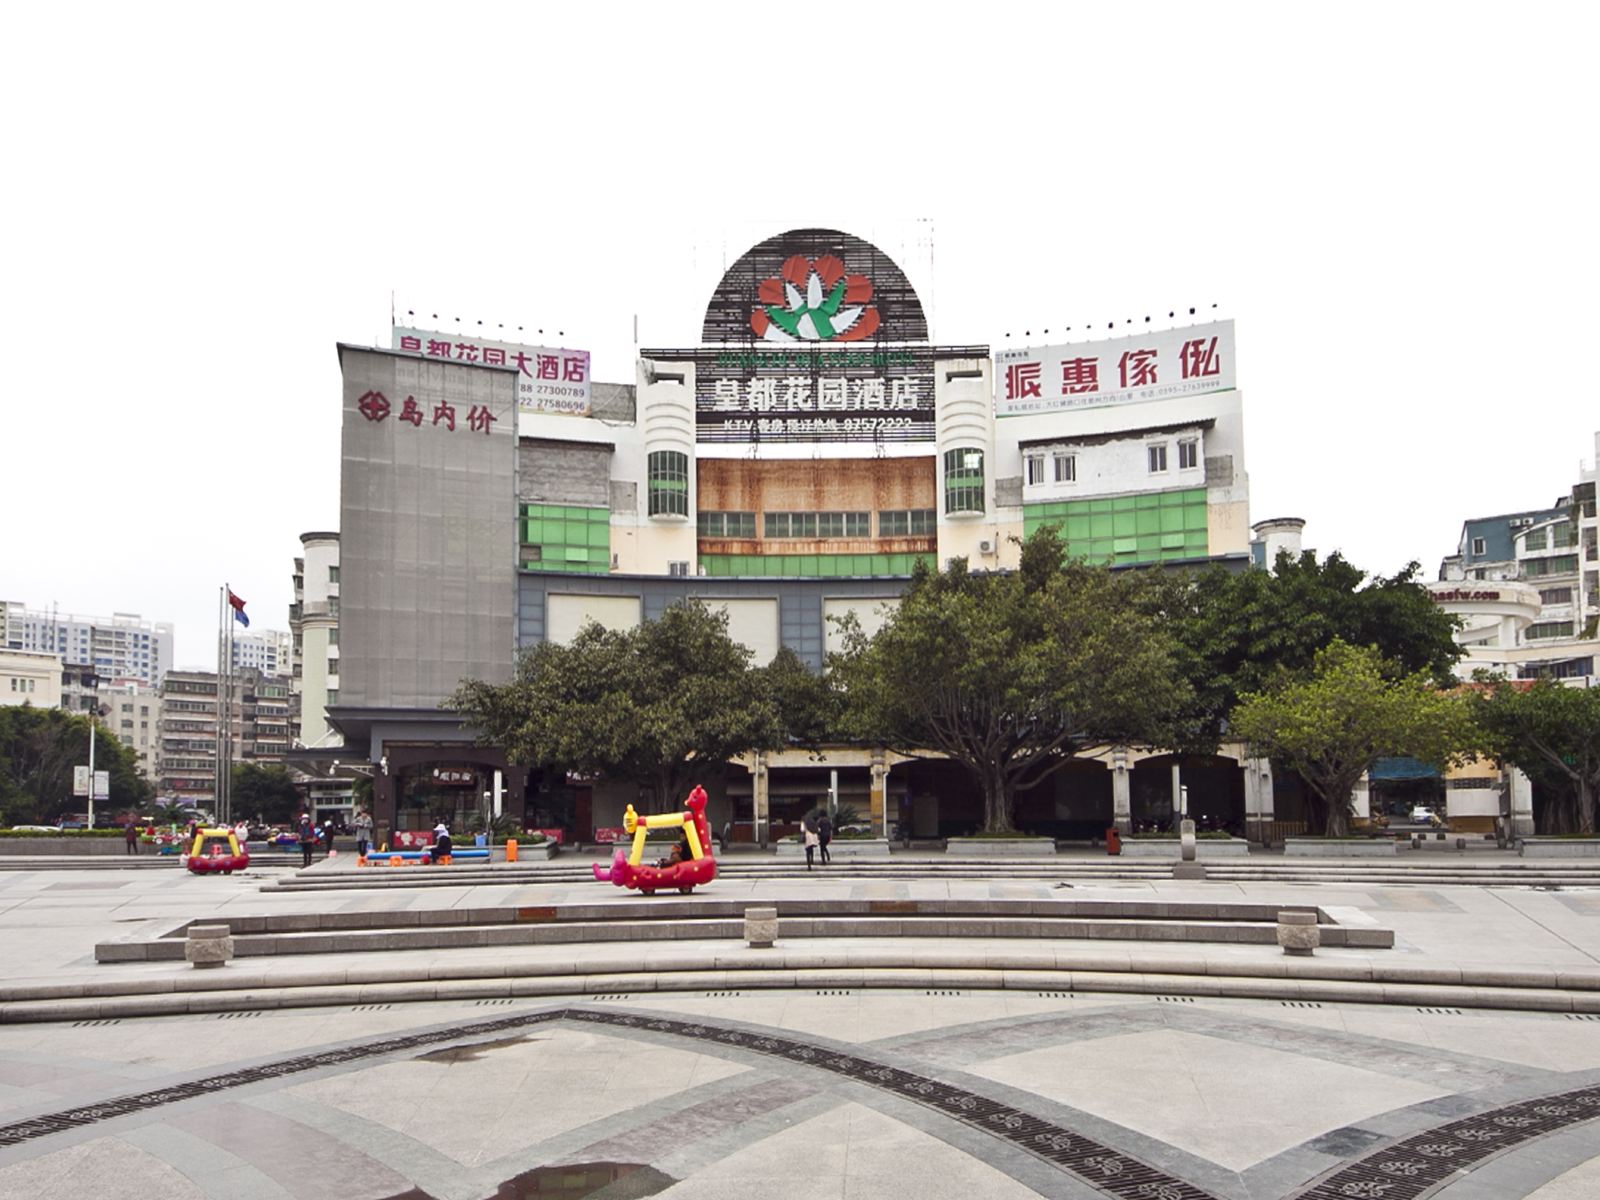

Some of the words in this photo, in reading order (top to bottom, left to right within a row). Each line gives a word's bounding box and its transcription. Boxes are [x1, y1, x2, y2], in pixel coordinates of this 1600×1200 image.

[536, 385, 585, 398] 27300789
[712, 375, 919, 412] 皇都花园酒店
[537, 398, 585, 411] 27580696
[399, 395, 498, 435] 岛内价
[723, 419, 753, 431] KTV
